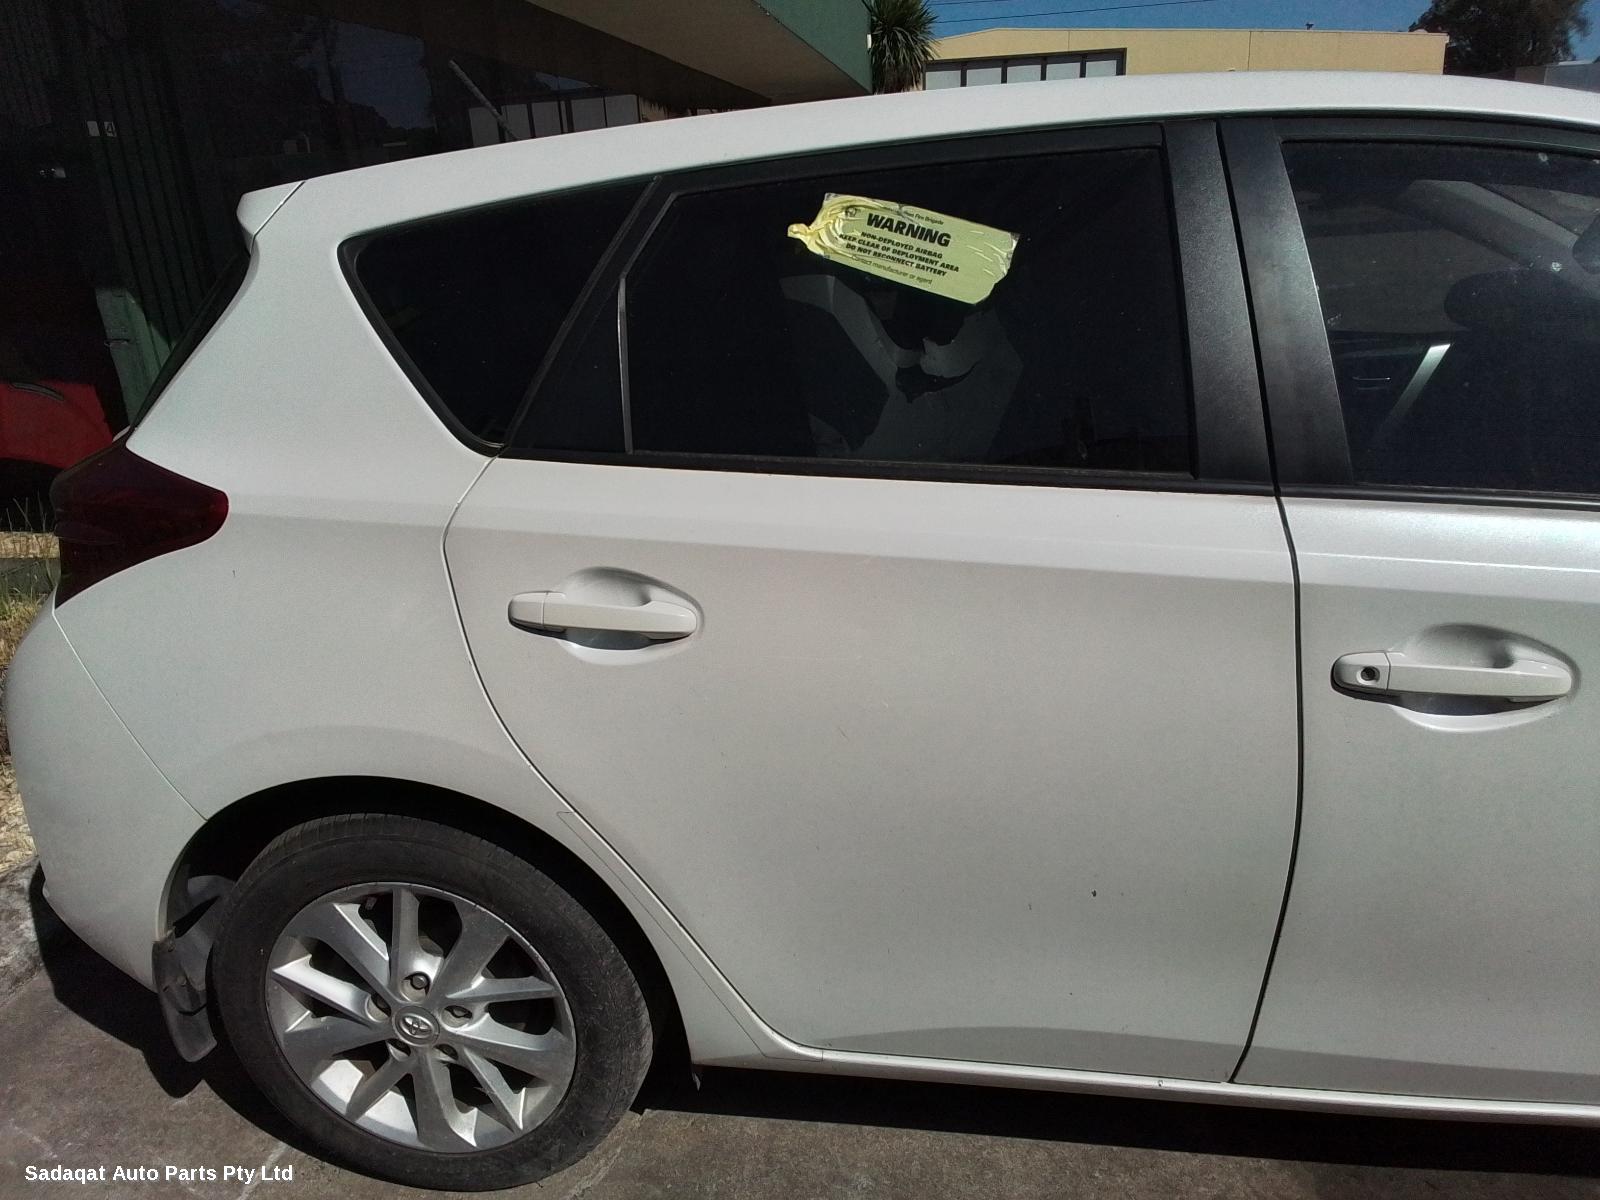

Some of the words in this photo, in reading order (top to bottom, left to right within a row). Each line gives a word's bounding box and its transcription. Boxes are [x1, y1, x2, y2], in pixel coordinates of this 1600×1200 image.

[861, 231, 914, 251] NON-DEPLOYED
[915, 247, 943, 259] AIRBAG
[867, 213, 951, 247] WARNING
[839, 233, 857, 241] KEEP
[858, 239, 880, 249] CLEAR
[892, 248, 939, 266] DEPLOYMENT
[939, 262, 960, 272] AREA
[846, 242, 856, 250] DO
[857, 247, 872, 255] NOT
[873, 251, 914, 267] RECONNECT
[915, 263, 947, 276] BATTERY
[873, 262, 908, 277] manufacturer
[916, 276, 932, 284] agent
